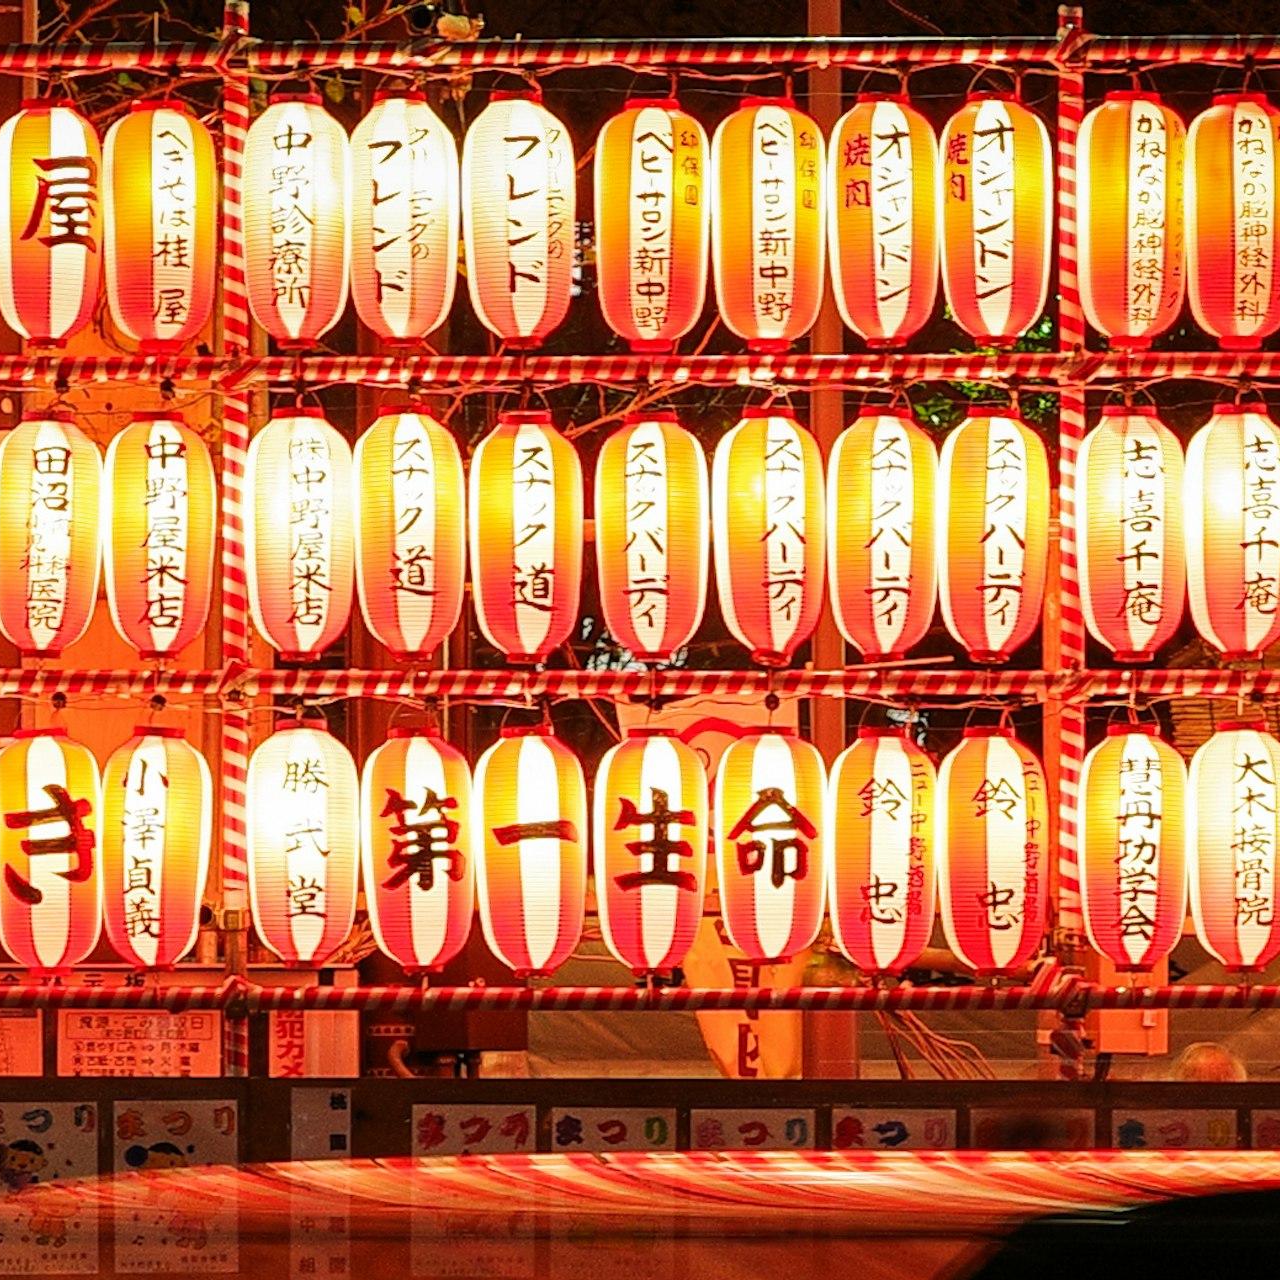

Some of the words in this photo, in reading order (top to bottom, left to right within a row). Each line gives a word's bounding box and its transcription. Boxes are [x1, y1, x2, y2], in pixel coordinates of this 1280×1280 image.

[268, 125, 313, 309] 中野診療所
[368, 138, 408, 303] フレンド
[503, 135, 544, 294] フレンド
[843, 132, 873, 210] 焼肉
[946, 133, 968, 203] 焼肉
[1131, 114, 1166, 326] かねなか脳神経外科
[1236, 114, 1270, 324] かねなか脳神経外科
[139, 435, 188, 629] 中野屋米店
[389, 437, 439, 596] スナック道
[511, 445, 558, 611] スナック道
[1116, 440, 1165, 626] 志喜千庵
[122, 760, 169, 937] 小澤貞義
[282, 759, 330, 917] 勝武堂
[382, 787, 817, 890] 第一生命
[1232, 753, 1276, 927] 大木接骨院
[116, 1107, 235, 1140] まつり
[417, 1111, 528, 1149] まつり
[556, 1115, 668, 1148] まつり
[695, 1117, 807, 1149] まつり
[835, 1115, 949, 1148] まつり
